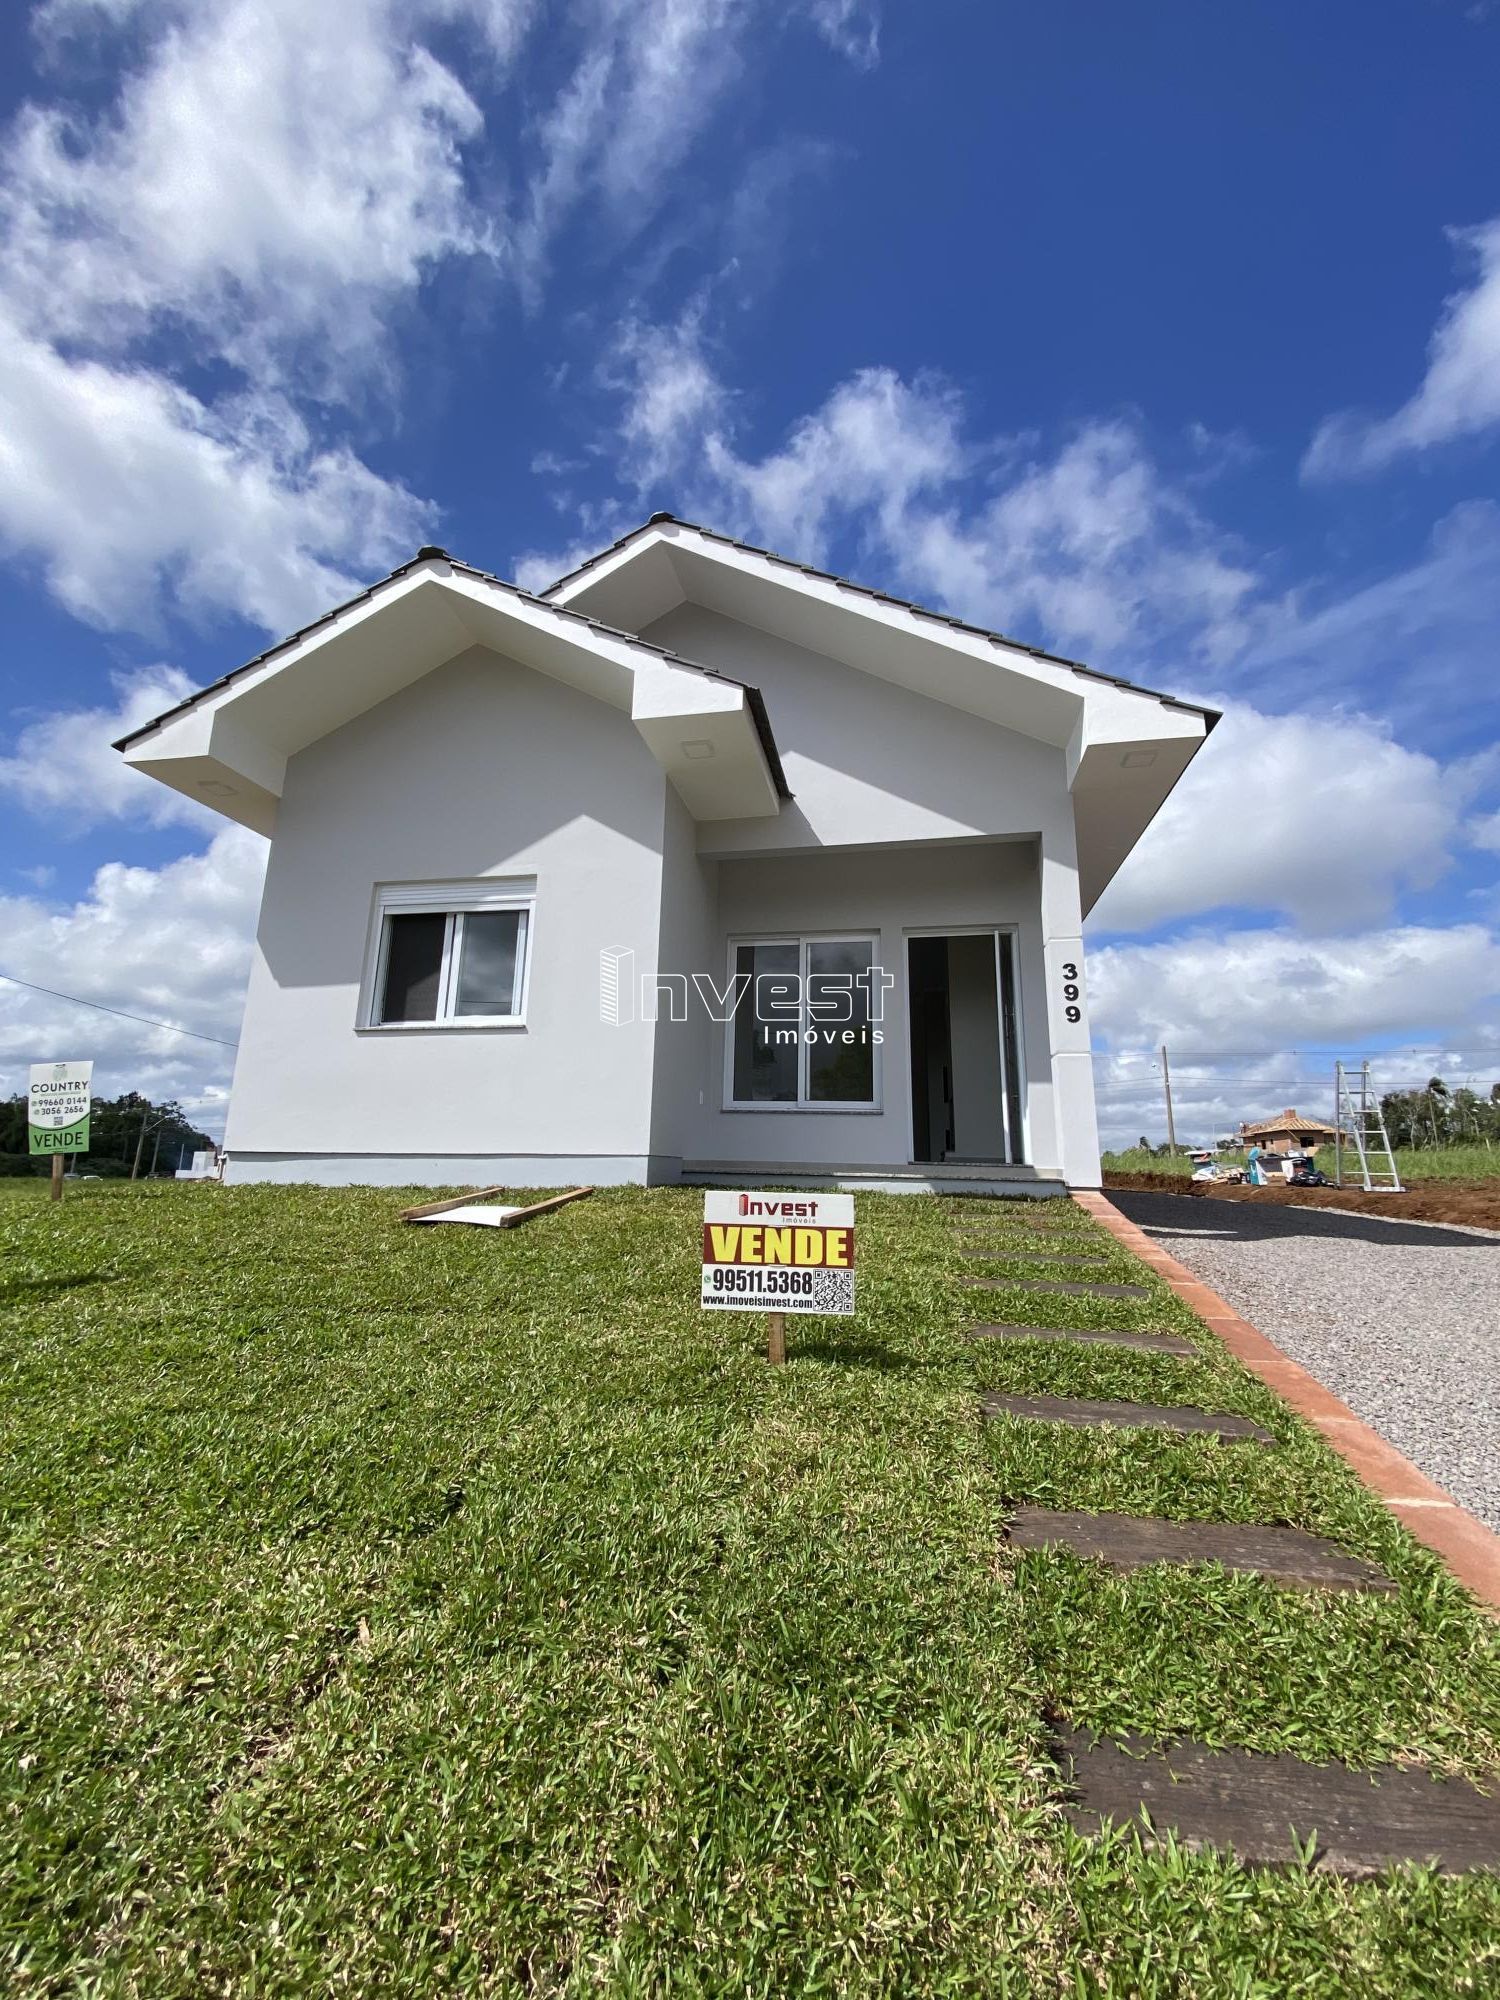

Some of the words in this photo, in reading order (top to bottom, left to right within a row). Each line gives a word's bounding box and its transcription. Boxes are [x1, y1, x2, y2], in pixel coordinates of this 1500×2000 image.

[1062, 963, 1081, 1023] 399
[31, 1081, 89, 1093] COUNTRY
[39, 1098, 64, 1107] 99660
[67, 1097, 87, 1105] 0144
[41, 1107, 61, 1115] 3056
[64, 1106, 84, 1114] 2656
[34, 1132, 84, 1147] VENDE
[739, 1194, 818, 1217] Invest
[710, 1226, 848, 1266] VENDE
[713, 1268, 813, 1294] 99511.5368
[702, 1295, 813, 1309] www.imoveisinvest.com
